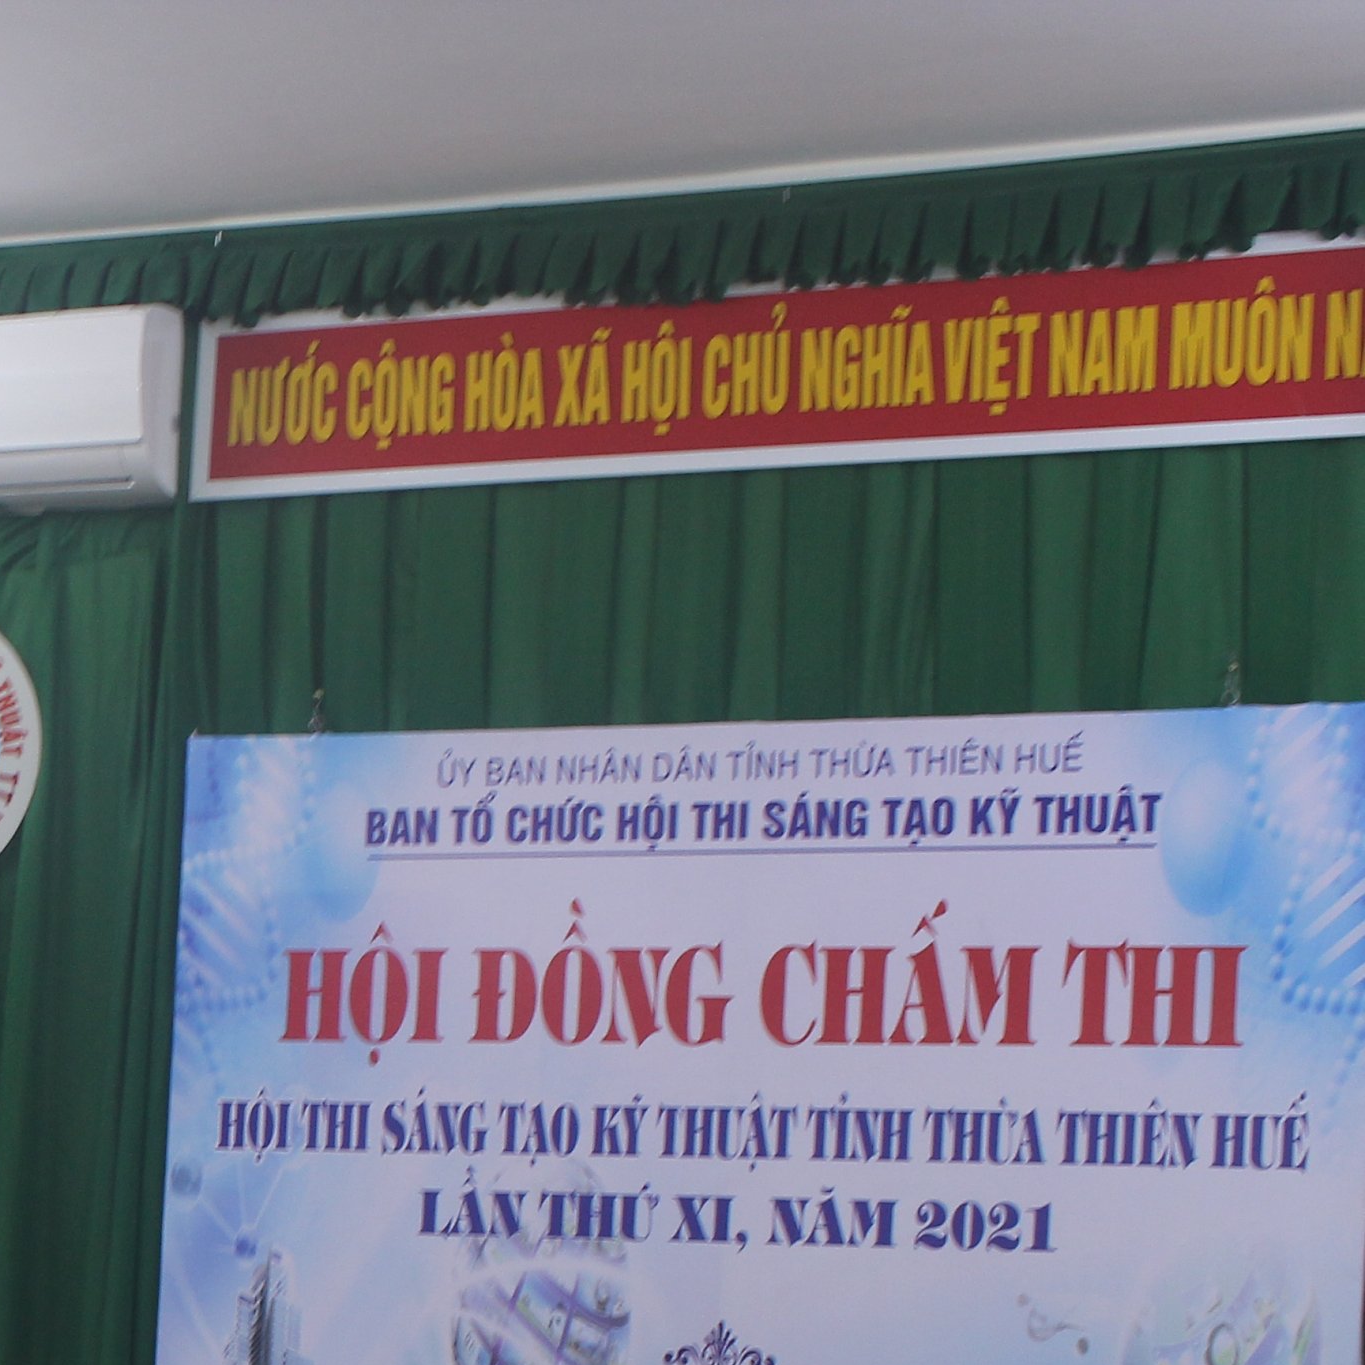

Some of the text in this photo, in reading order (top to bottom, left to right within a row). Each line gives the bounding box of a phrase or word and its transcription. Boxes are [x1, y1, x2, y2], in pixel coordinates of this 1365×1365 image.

[230, 277, 1365, 449] NƯỚC CỘNG HÒA XÃ HỘI CHỦ NGHĨA VIỆT NAM MUÔN N
[485, 756, 548, 787] BAN
[556, 746, 643, 785] NHÂN
[652, 745, 717, 783] DÂN
[725, 740, 800, 781] TỈNH
[809, 740, 896, 778] THỪA
[904, 737, 1004, 776] THIÊN
[1014, 729, 1085, 774] HUẾ
[365, 784, 1163, 853] BAN TỔ CHỨC HỘI THI SÁNG TẠO KỸ THUẬT
[281, 898, 1248, 1066] HỘI ĐỒNG CHẤM THI
[301, 1099, 371, 1152] THI
[381, 1087, 488, 1155] SÁNG
[498, 1102, 580, 1166] TẠO
[1056, 1099, 1202, 1170] THIÊN
[1210, 1091, 1310, 1173] HUẾ
[538, 1183, 660, 1242] THỨ
[669, 1195, 749, 1254] XI,
[766, 1187, 897, 1248] NĂM
[913, 1200, 1058, 1253] 2021
